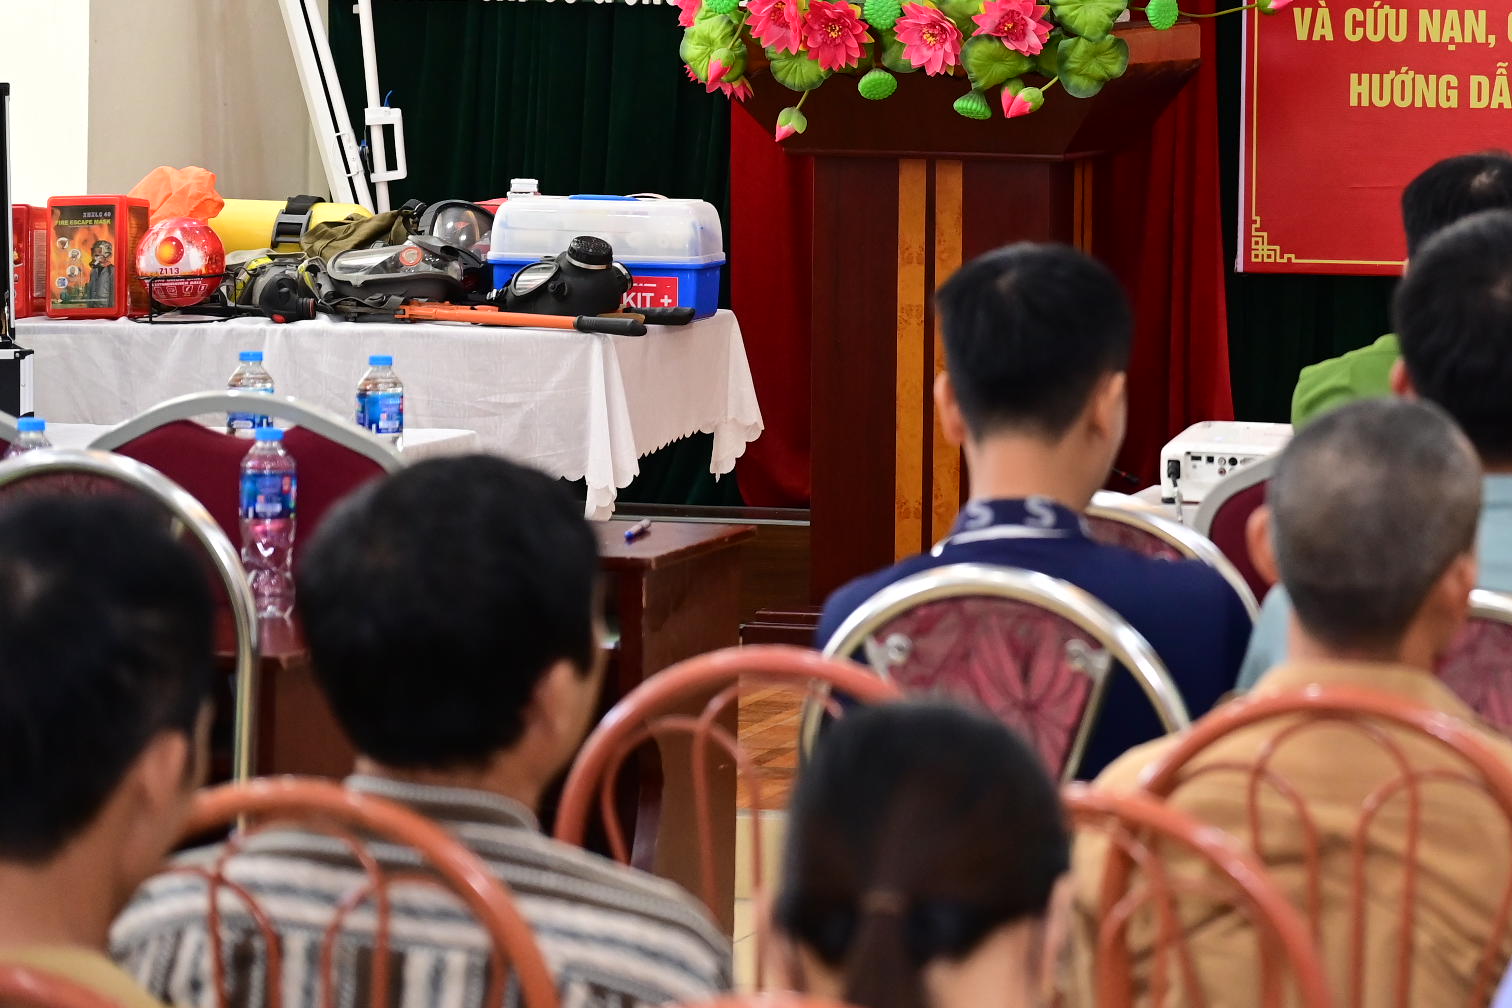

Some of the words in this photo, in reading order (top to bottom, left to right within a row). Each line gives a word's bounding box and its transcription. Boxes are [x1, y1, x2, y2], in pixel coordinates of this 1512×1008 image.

[1293, 0, 1334, 41] VÀ
[1344, 0, 1408, 43] CỨU
[1418, 8, 1496, 51] NẠN,
[1349, 66, 1459, 109] HƯỚNG
[623, 292, 655, 308] KIT
